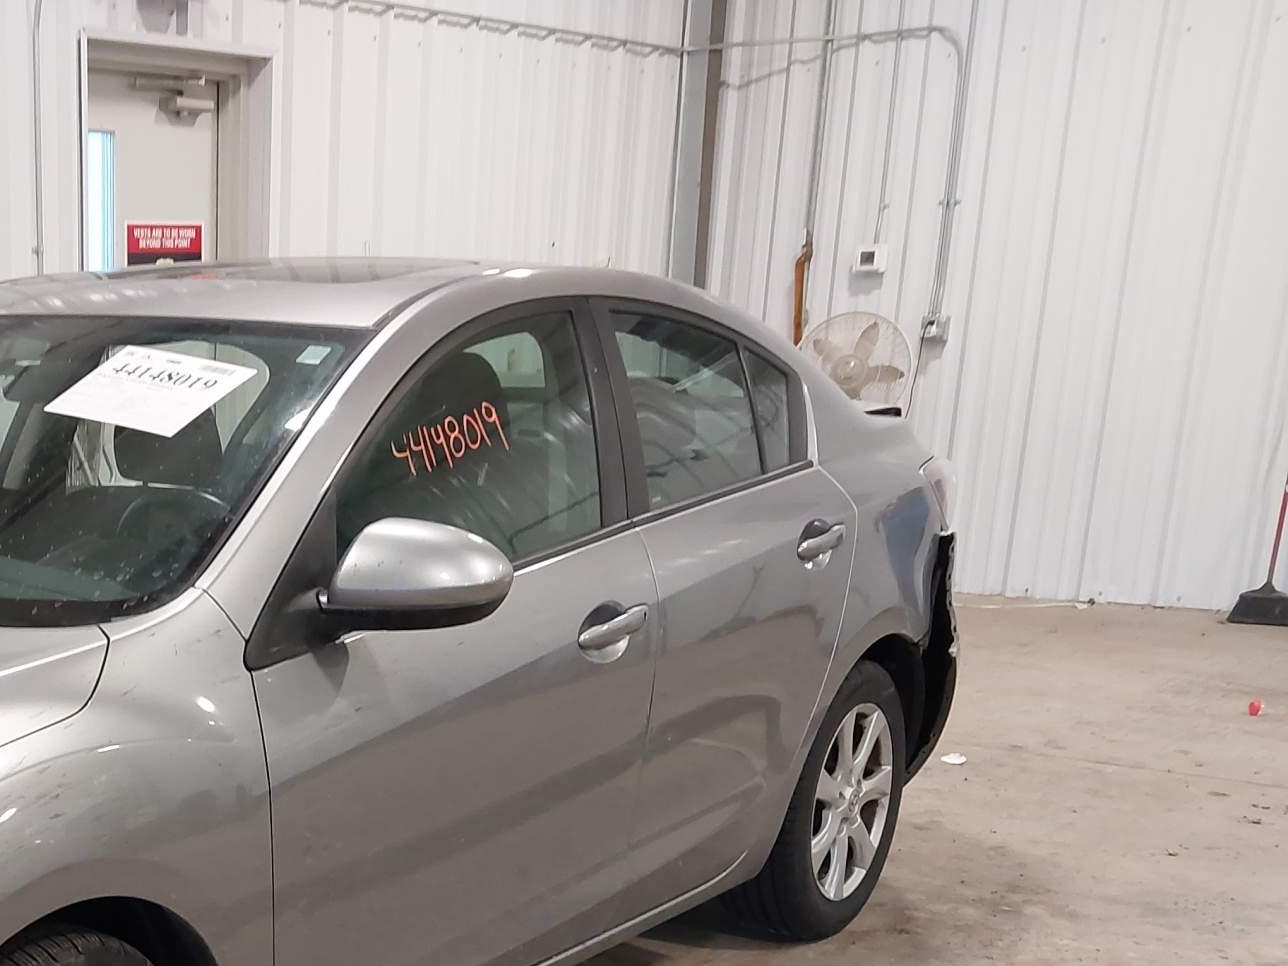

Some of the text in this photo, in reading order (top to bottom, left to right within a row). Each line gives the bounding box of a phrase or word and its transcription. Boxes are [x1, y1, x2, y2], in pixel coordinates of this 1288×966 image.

[134, 227, 196, 240] VESTS ARE TO BE WORN
[139, 238, 191, 249] BEYOND THIS POINT
[112, 363, 218, 390] 44148019
[391, 401, 510, 476] 44148019
